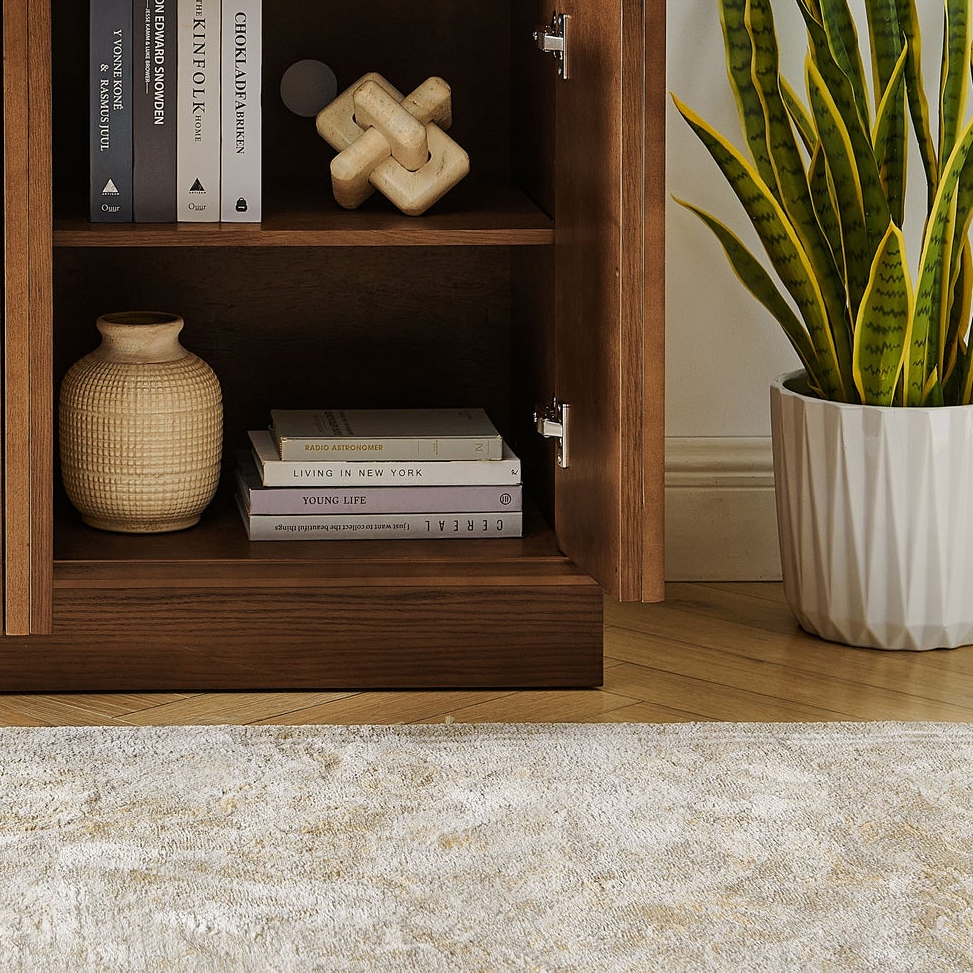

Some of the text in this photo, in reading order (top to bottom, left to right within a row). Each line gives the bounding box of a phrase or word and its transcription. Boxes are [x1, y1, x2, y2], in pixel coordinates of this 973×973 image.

[154, 15, 165, 64] EDWARD
[192, 17, 206, 114] KINFOLK
[113, 79, 124, 111] KONÉ
[154, 67, 164, 125] SNOWDEN
[234, 11, 247, 154] CHOKLADFABRIKEN
[99, 63, 110, 152] & RASMUS JUUL
[194, 115, 202, 142] HOME
[340, 469, 352, 477] IN
[358, 469, 385, 477] NEW
[390, 469, 423, 477] YORK
[302, 496, 367, 505] YOUNG LIFE
[274, 523, 297, 532] things
[298, 524, 329, 532] beautiful
[392, 522, 407, 531] just
[425, 520, 504, 532] CEREAL
